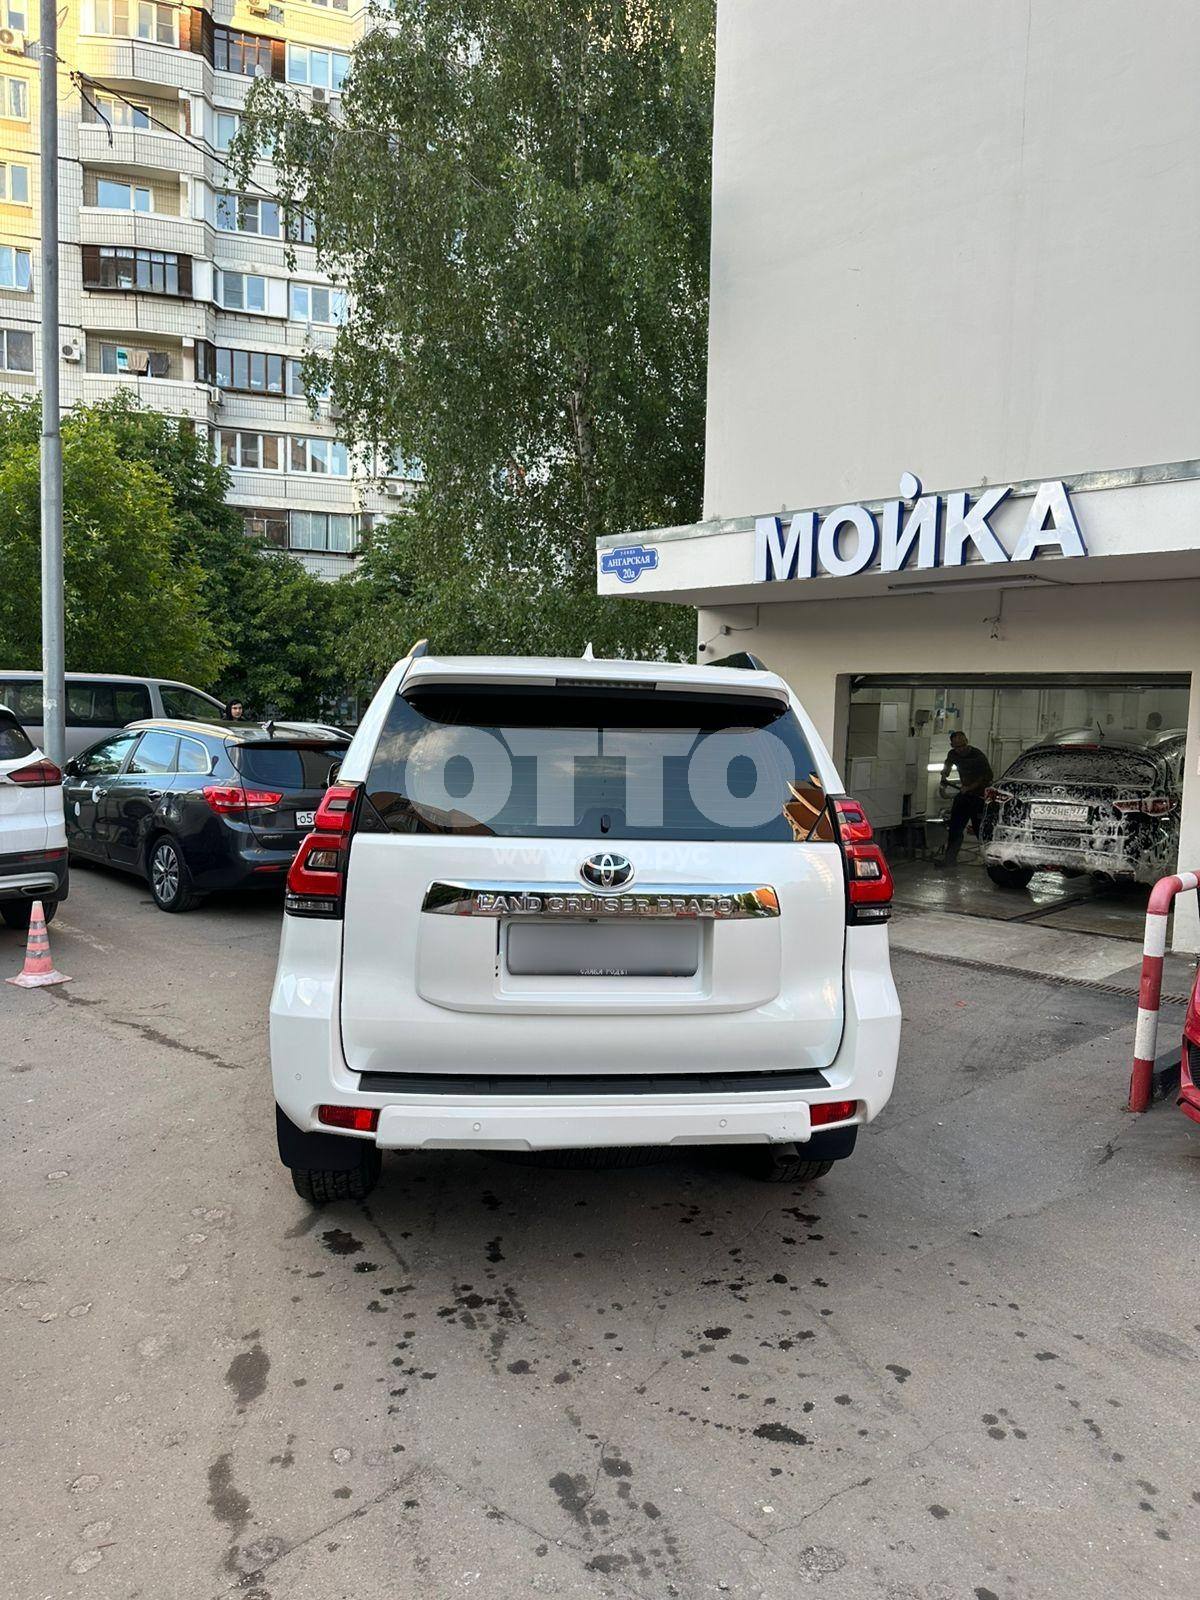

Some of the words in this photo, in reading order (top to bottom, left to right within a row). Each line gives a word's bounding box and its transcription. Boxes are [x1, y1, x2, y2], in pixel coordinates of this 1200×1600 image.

[754, 472, 1087, 581] МОЙКА
[608, 555, 650, 568] АНГАРСКАЯ
[477, 894, 542, 912] LAND
[549, 895, 650, 913] CRUISER
[657, 895, 733, 914] PRADO
